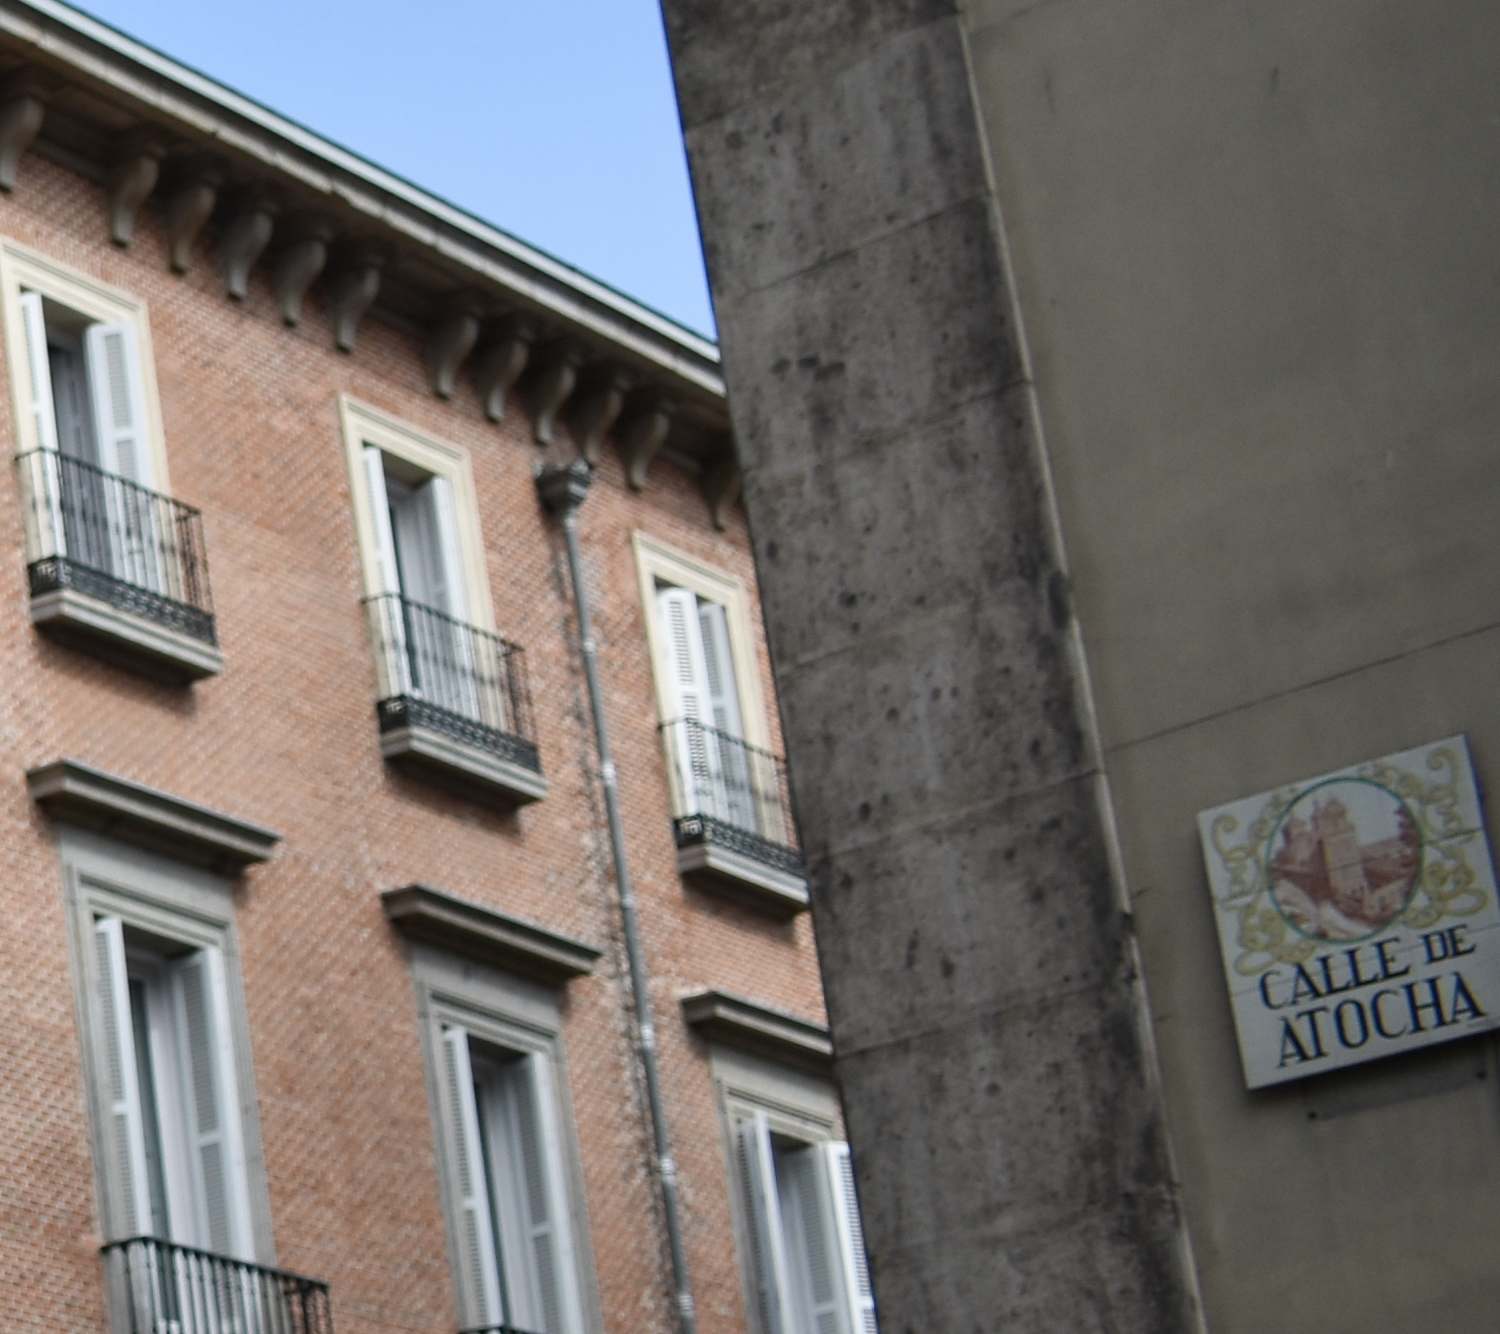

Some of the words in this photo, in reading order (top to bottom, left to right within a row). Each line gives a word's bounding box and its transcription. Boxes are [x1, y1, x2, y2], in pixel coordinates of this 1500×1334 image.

[1257, 935, 1411, 1012] CALLE
[1421, 922, 1477, 966] DE
[1276, 970, 1488, 1070] ATOCHA
